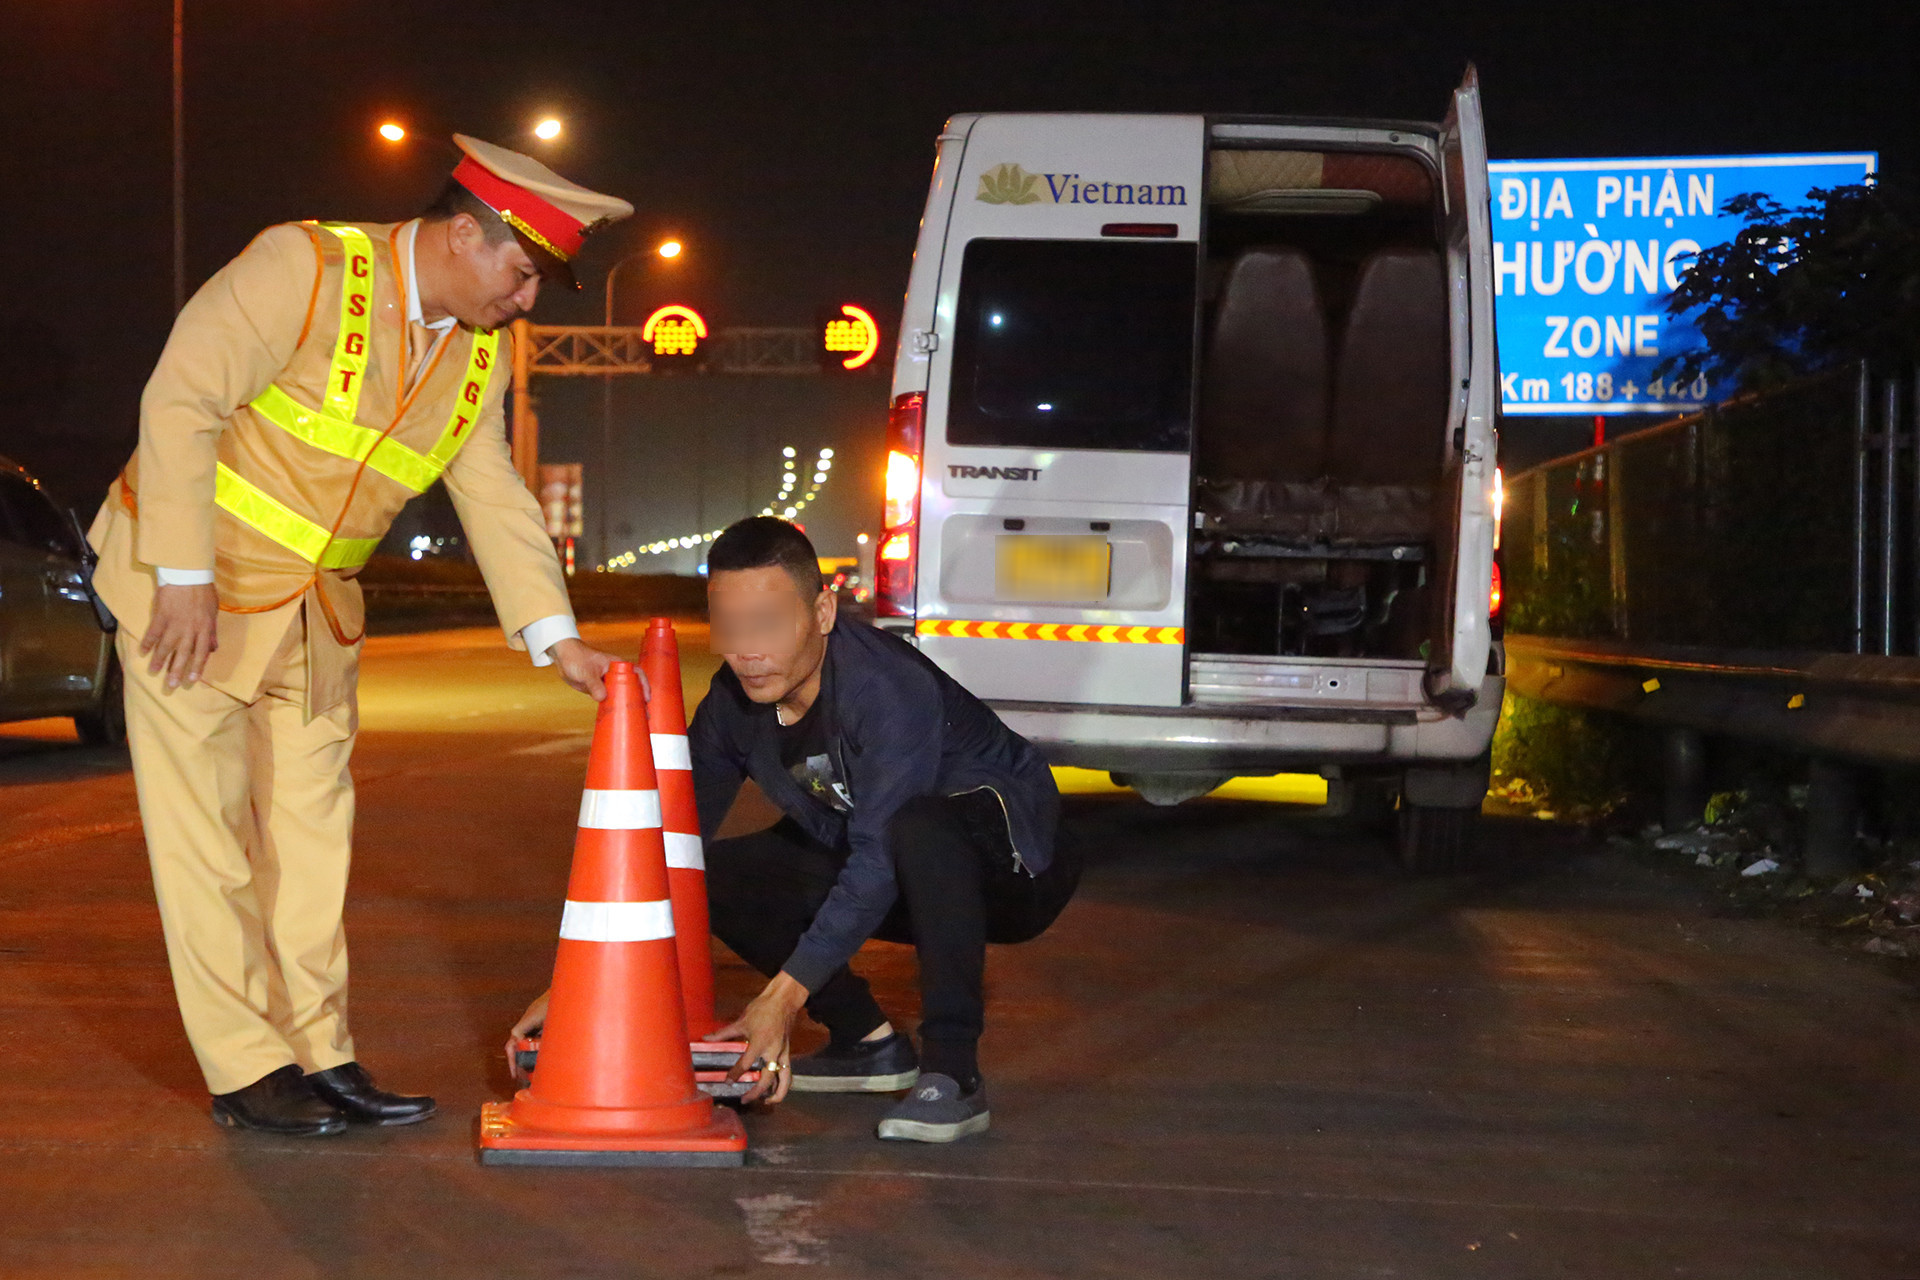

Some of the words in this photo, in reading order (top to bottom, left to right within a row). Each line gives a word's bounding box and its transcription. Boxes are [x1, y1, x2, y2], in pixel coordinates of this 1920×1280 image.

[1044, 173, 1187, 206] Vietnam
[1498, 177, 1574, 231] ĐỊA
[1597, 168, 1715, 228] PHẬN
[1494, 223, 1702, 296] HƯỜNG
[1543, 315, 1659, 358] ZONE
[452, 329, 494, 437] SGT
[1500, 373, 1550, 401] Km
[1560, 372, 1614, 401] 188
[947, 464, 1042, 481] TRANSIT
